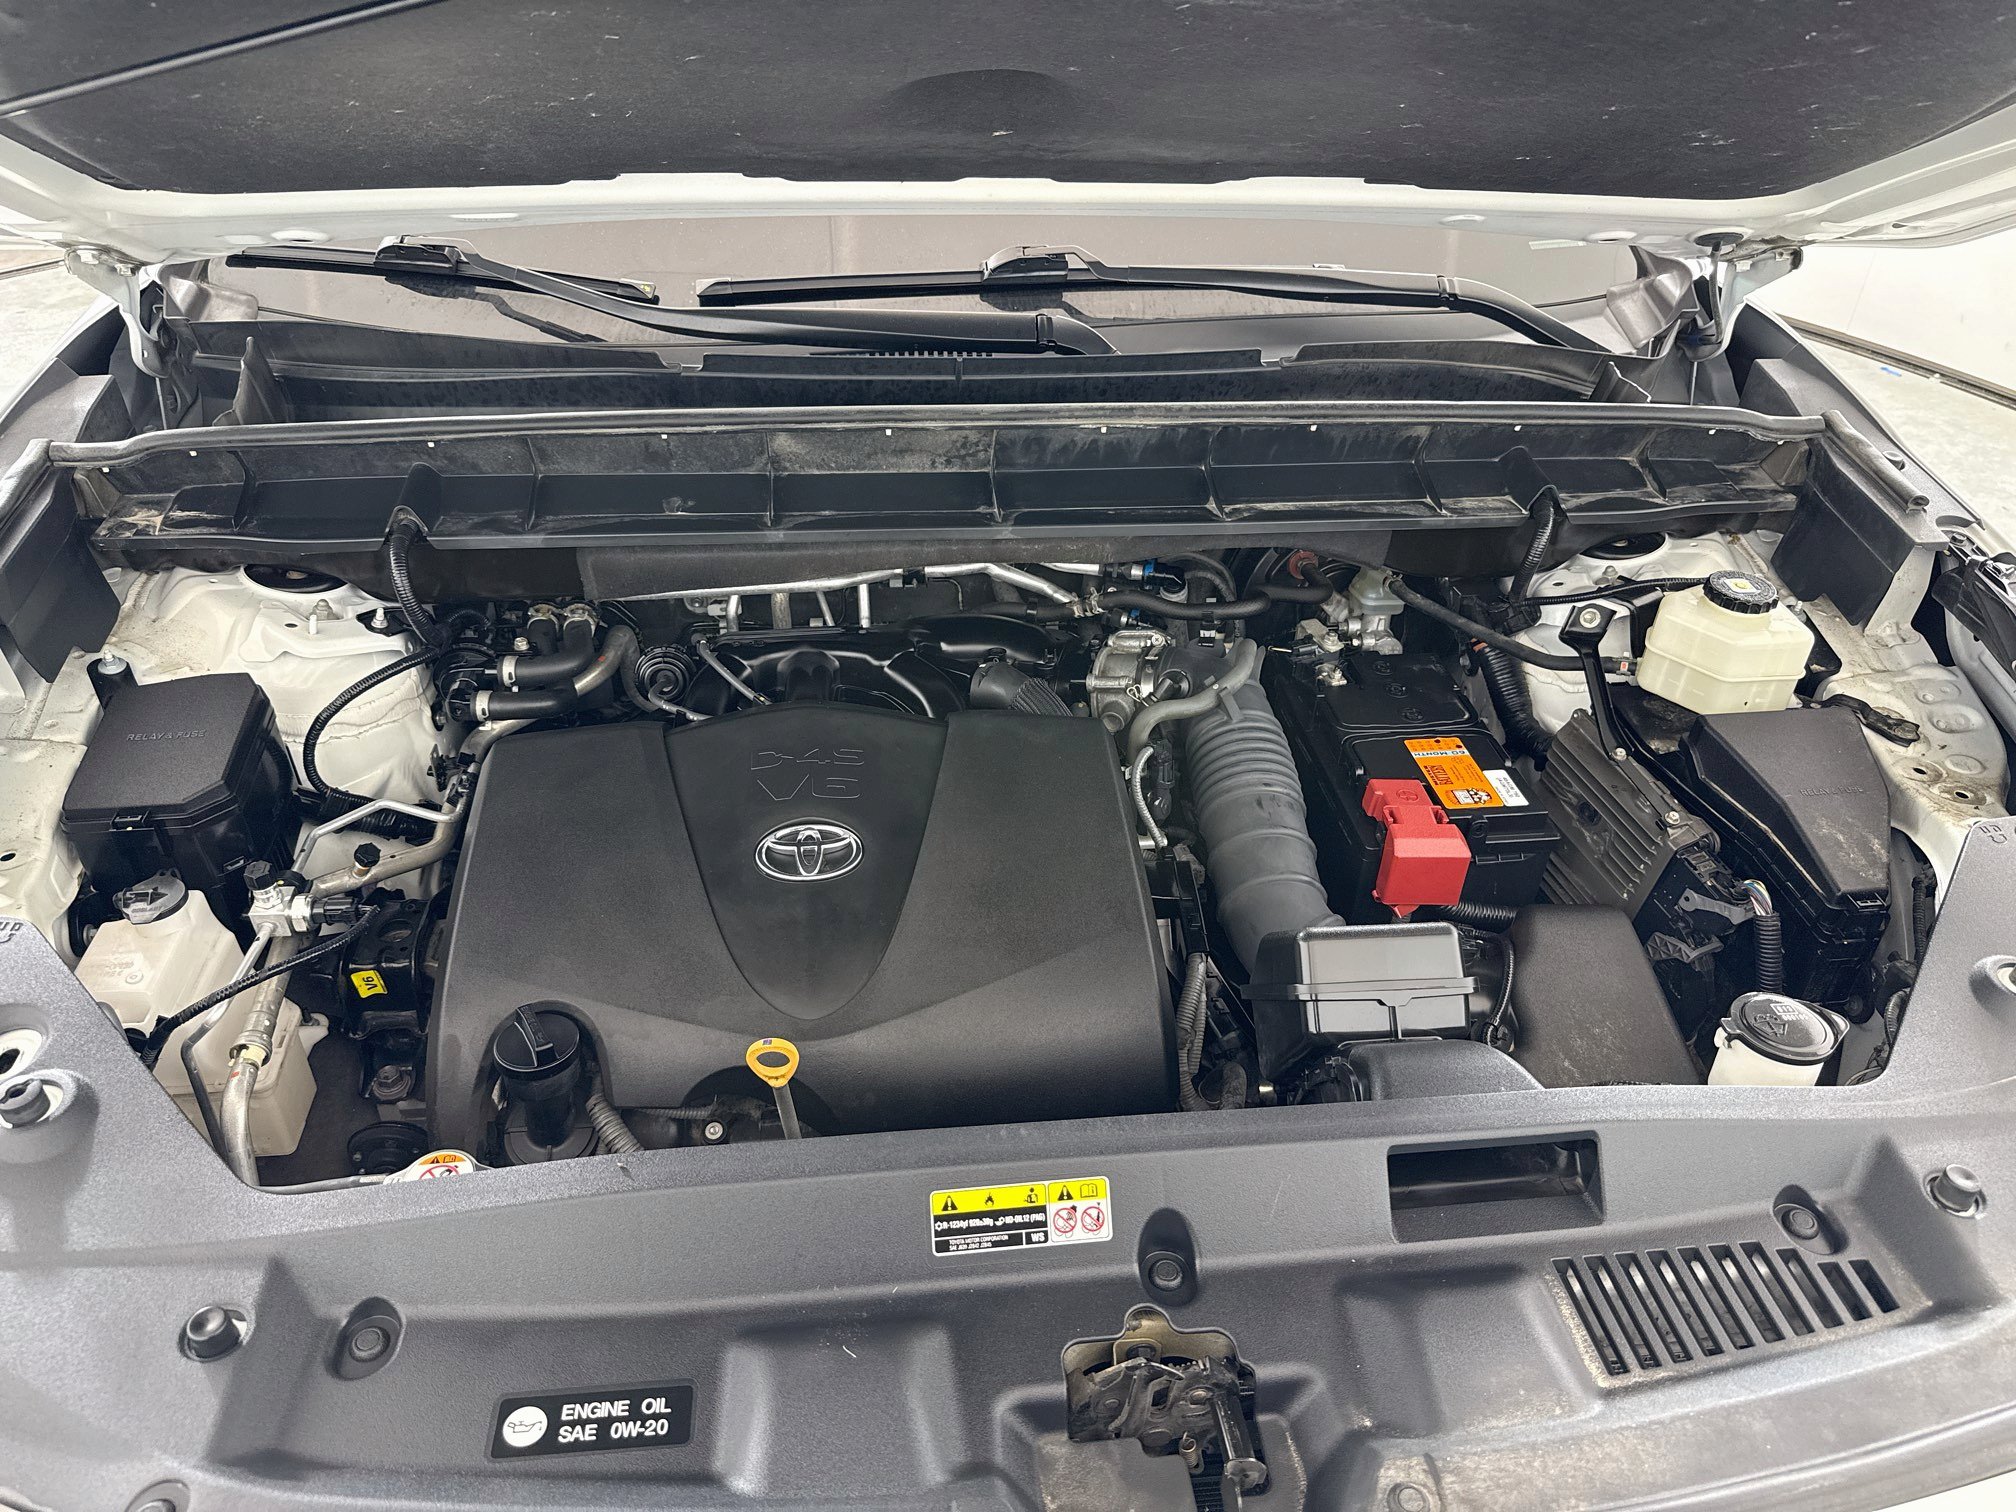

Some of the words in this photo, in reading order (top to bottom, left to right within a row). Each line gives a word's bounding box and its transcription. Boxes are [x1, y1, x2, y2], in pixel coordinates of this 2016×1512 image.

[126, 732, 164, 741] RELAY
[176, 729, 207, 739] FUSE
[756, 773, 862, 801] V6
[1800, 787, 1830, 796] RELAY
[1839, 785, 1864, 794] FUSE
[362, 975, 378, 991] V6
[965, 1236, 980, 1244] MOTOR
[980, 1234, 1009, 1242] CORPORATION
[1030, 1231, 1046, 1242] WS
[560, 1399, 631, 1421] ENGINE
[640, 1397, 672, 1415] OIL
[557, 1423, 599, 1443] SAE
[609, 1418, 669, 1440] 0W-20
